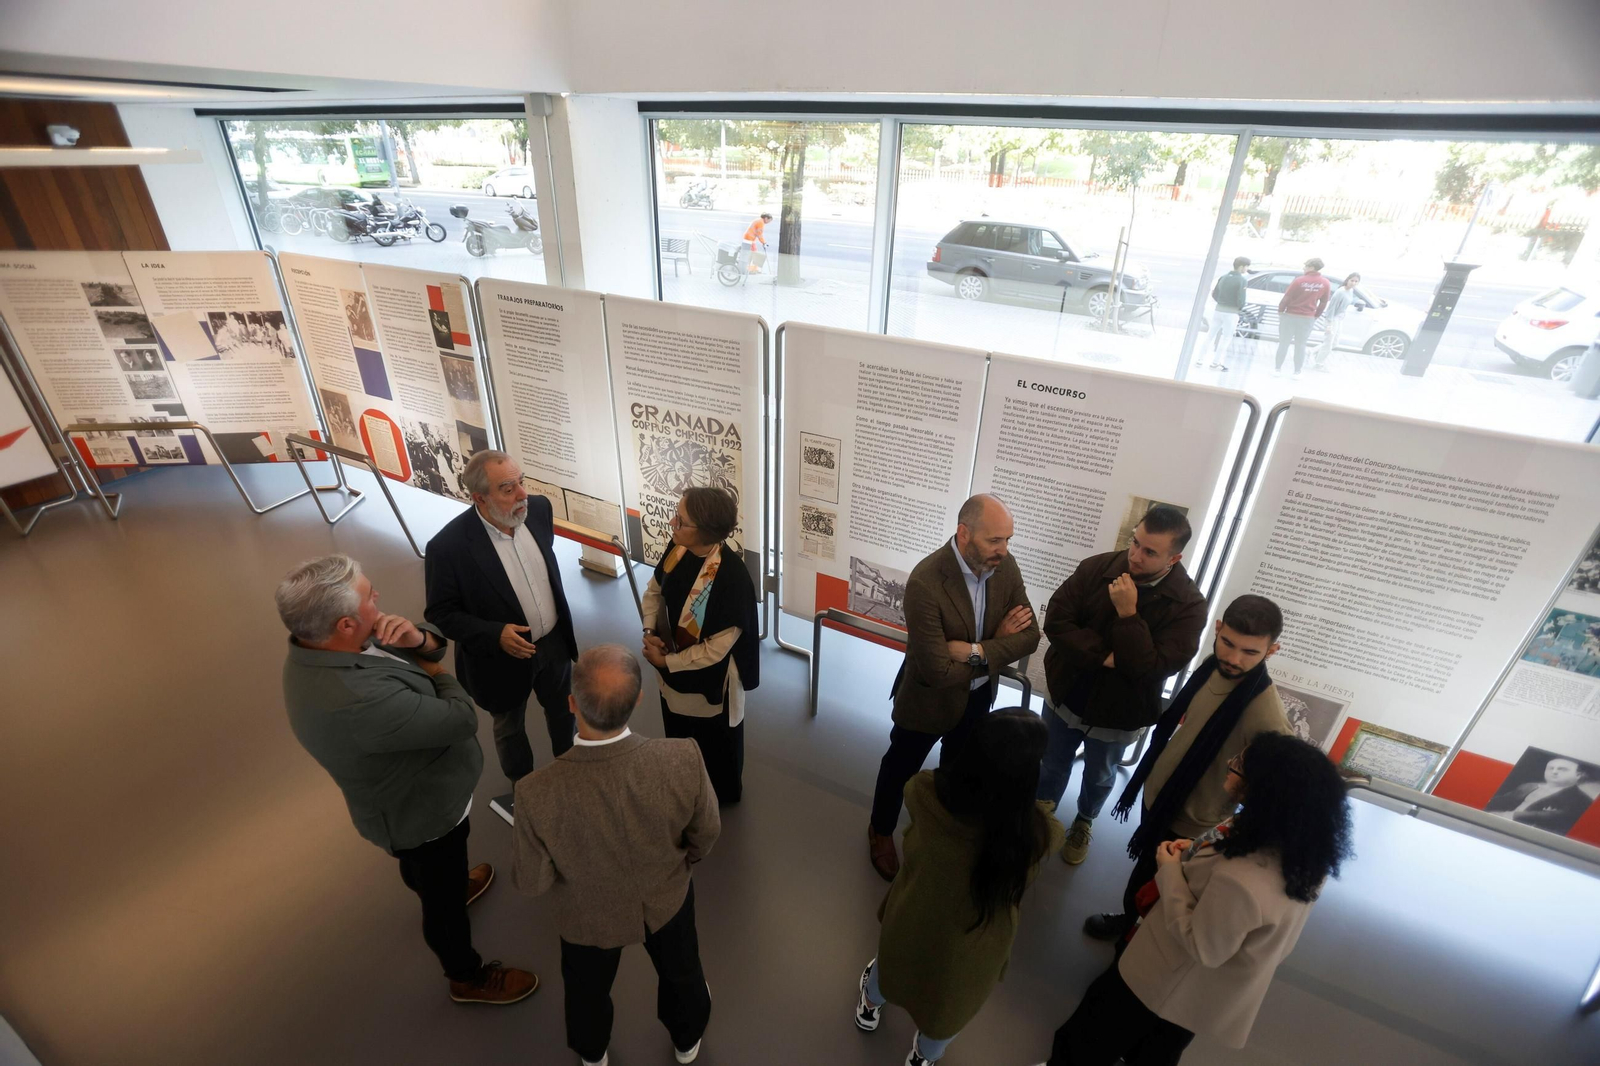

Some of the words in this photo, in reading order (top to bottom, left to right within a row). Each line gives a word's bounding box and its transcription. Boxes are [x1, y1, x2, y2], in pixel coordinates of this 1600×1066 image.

[497, 294, 523, 304] TRABAJOS
[524, 298, 564, 312] PREPARATORIOS
[1016, 379, 1027, 389] EL
[1031, 382, 1087, 400] CONCURSO
[631, 402, 741, 441] GRANADA
[1047, 405, 1074, 414] escenario
[632, 419, 671, 436] CORPUS
[675, 428, 717, 446] CHRISTI
[721, 439, 742, 452] 1922
[1304, 447, 1316, 455] Las
[1328, 453, 1353, 462] noches
[1364, 458, 1397, 470] Concurso
[1414, 470, 1457, 482] espectaculares,
[1464, 478, 1496, 489] decoración
[1526, 490, 1560, 501] deslumbró
[1304, 457, 1332, 466] granadinos
[1336, 462, 1363, 472] forasteros.
[1370, 469, 1389, 477] Centro
[1389, 473, 1413, 482] Artístico
[1448, 485, 1490, 496] especialmente
[1500, 495, 1526, 504] señoras,
[1528, 500, 1555, 508] vistieran
[646, 494, 679, 508] CONCURS
[1312, 497, 1333, 505] comenzó
[1340, 502, 1362, 511] discurso
[1362, 506, 1379, 514] Gómez
[1468, 529, 1500, 540] impaciencia
[1509, 538, 1531, 546] público,
[1318, 617, 1355, 631] importantes
[1291, 674, 1304, 684] DE
[1306, 679, 1319, 688] LA
[1322, 683, 1354, 698] FIESTA
